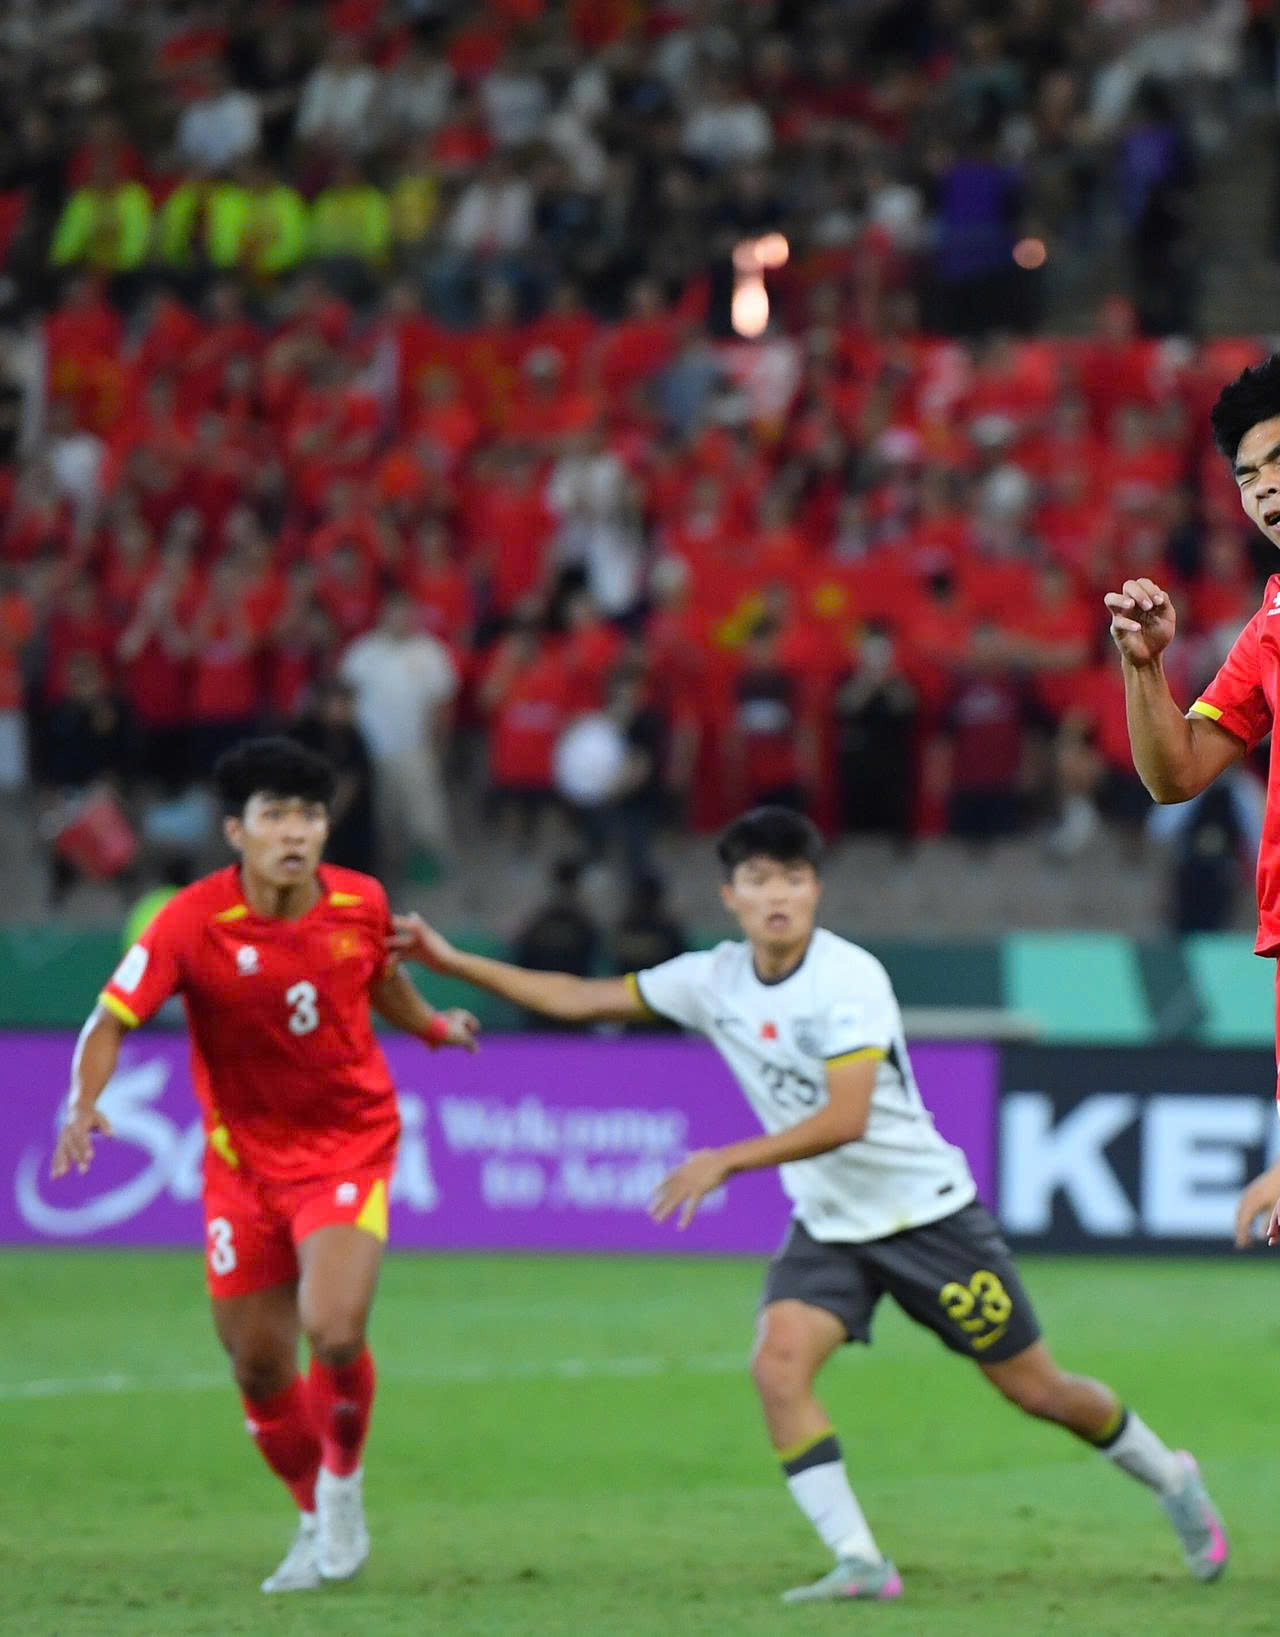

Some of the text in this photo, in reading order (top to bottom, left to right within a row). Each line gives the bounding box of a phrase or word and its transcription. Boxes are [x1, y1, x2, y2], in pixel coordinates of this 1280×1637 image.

[286, 980, 320, 1036] 3
[207, 1216, 237, 1276] 3
[939, 1269, 1013, 1333] 23
